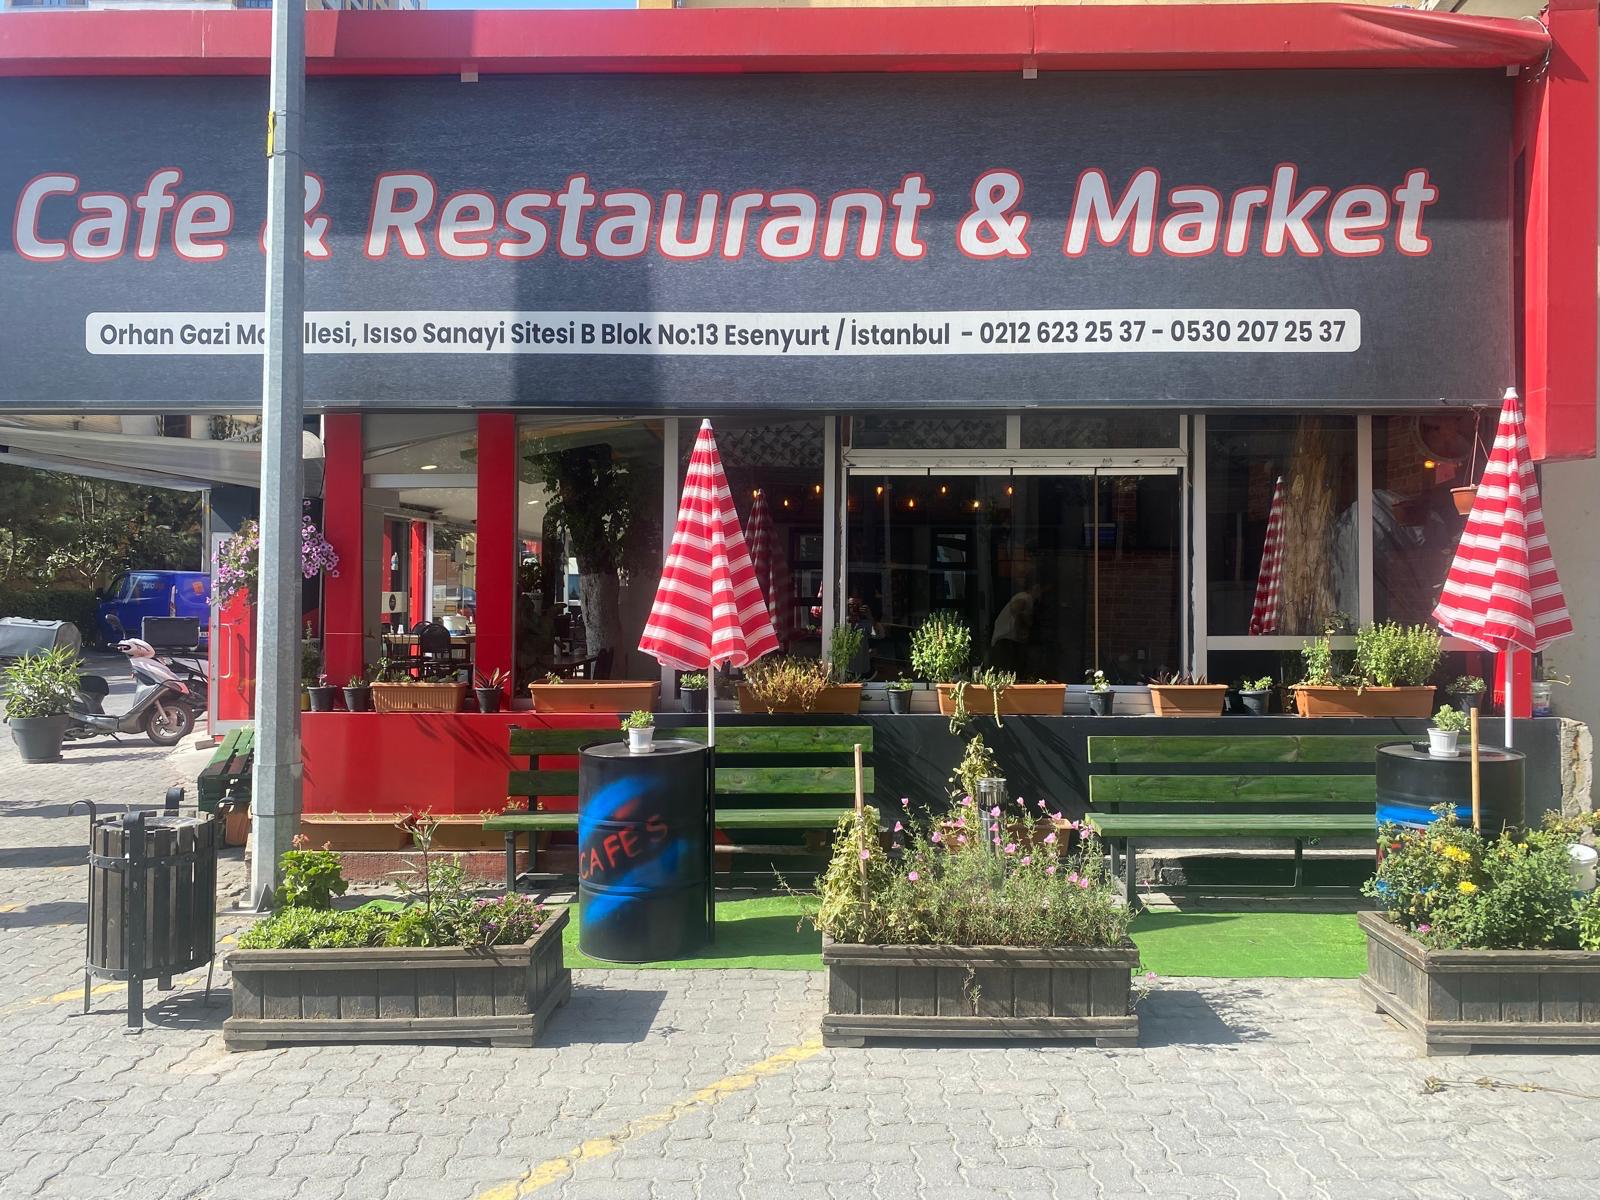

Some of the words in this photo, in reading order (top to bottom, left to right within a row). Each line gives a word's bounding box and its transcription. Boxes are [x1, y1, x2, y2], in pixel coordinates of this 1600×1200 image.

[14, 166, 234, 261] Cafe
[364, 170, 935, 261] Restaurant
[957, 168, 1031, 259] &
[1062, 162, 1440, 259] Market
[100, 323, 173, 345] Orhan
[180, 322, 230, 345] Gazi
[236, 320, 357, 347] Mllesi,
[423, 320, 505, 351] Sanayi
[511, 320, 575, 344] Sitesi
[581, 323, 596, 345] B
[601, 322, 653, 345] Blok
[658, 323, 719, 345] No:13
[725, 324, 830, 353] Esenyurt
[834, 317, 846, 351] /
[851, 319, 950, 346] İstanbul
[980, 321, 1031, 344] 0212
[1037, 321, 1078, 344] 623
[1085, 321, 1113, 343] 25
[1119, 320, 1146, 342] 37
[1170, 320, 1231, 342] 0530
[1237, 320, 1279, 342] 207
[1284, 320, 1313, 342] 25
[1319, 320, 1346, 342] 37
